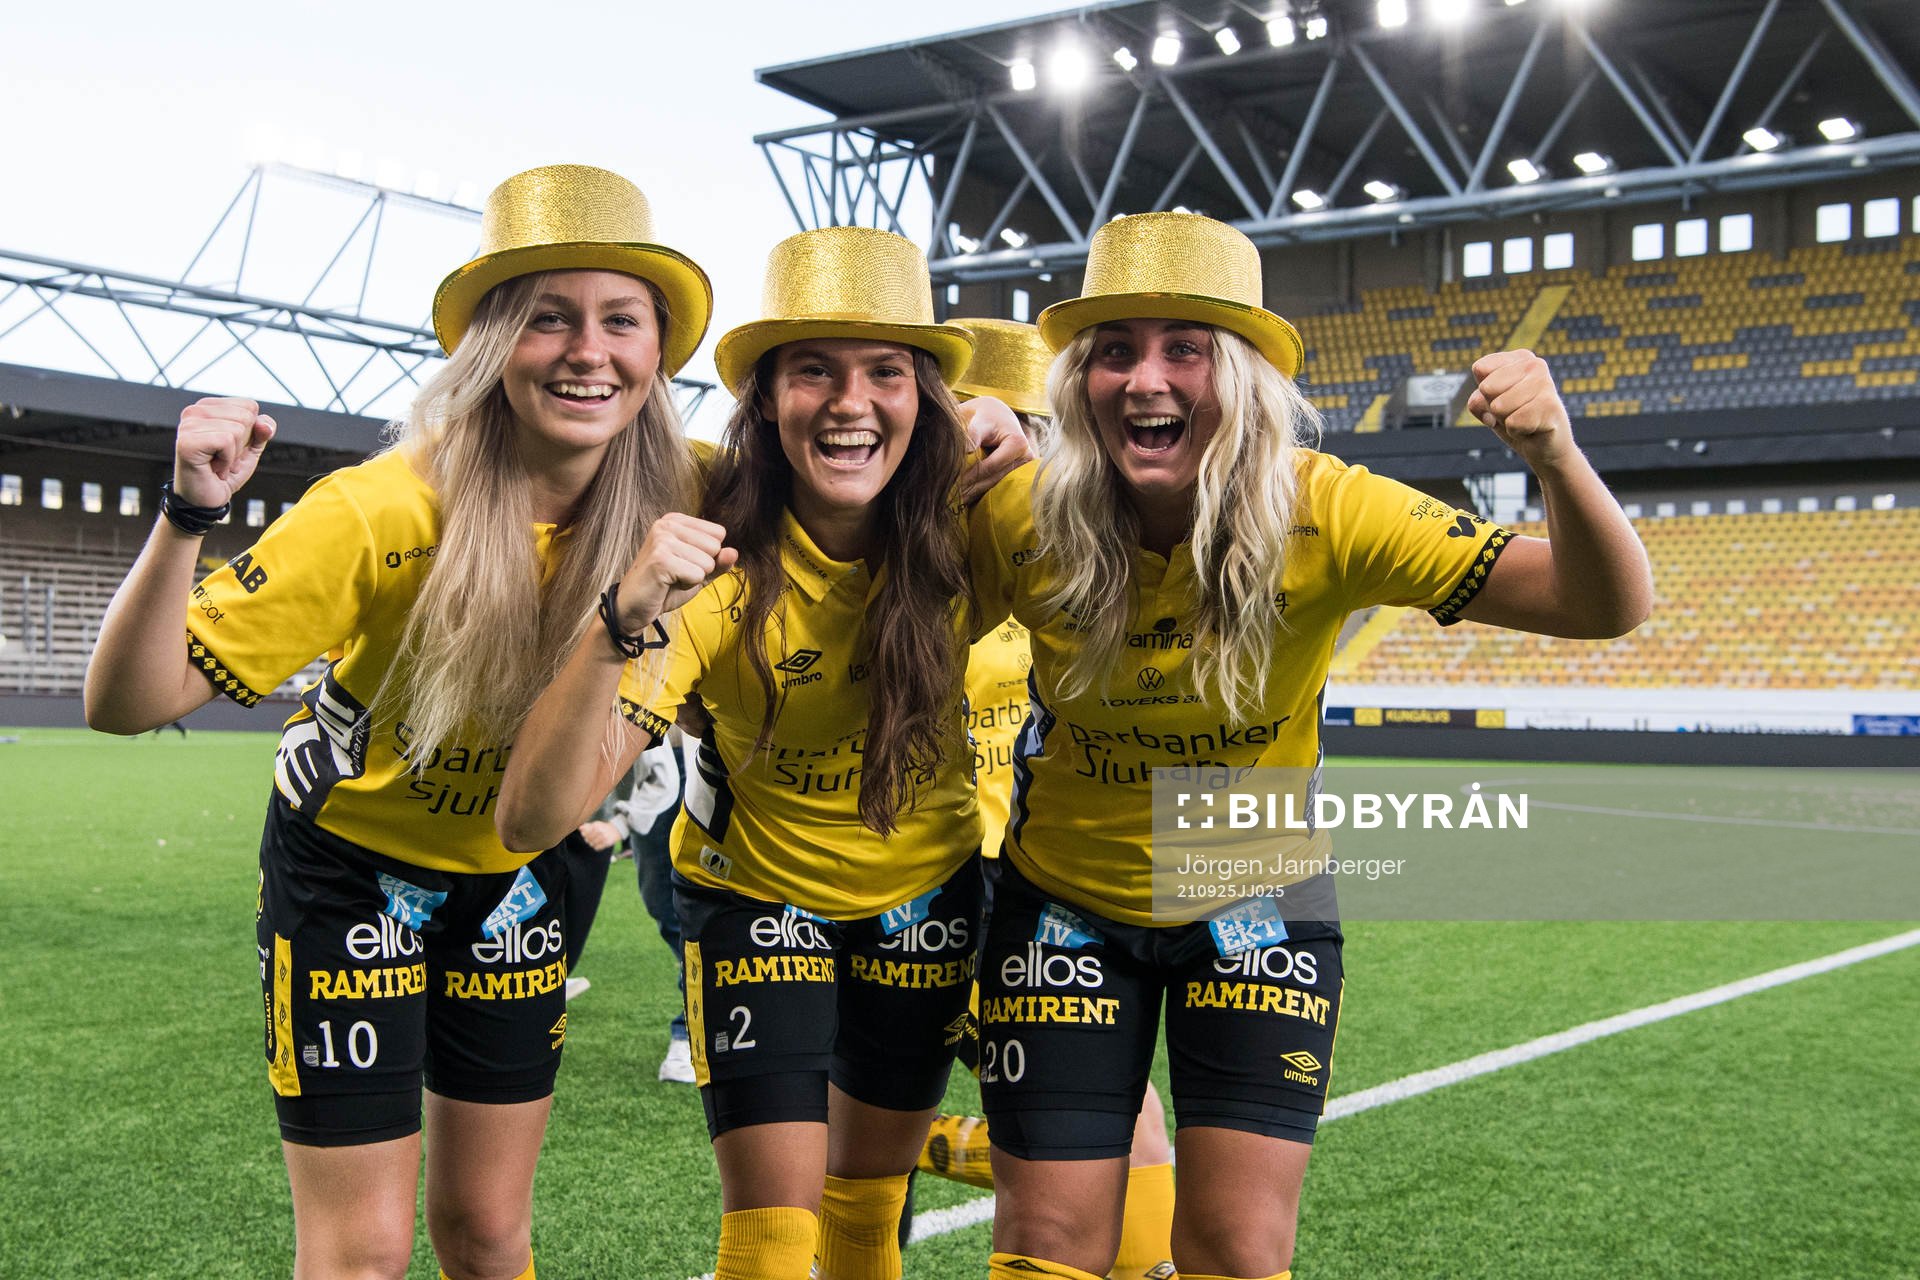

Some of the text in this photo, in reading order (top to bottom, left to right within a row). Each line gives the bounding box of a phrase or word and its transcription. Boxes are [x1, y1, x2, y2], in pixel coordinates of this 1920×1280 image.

[229, 552, 268, 594] AB
[781, 671, 823, 689] umbro
[715, 956, 834, 987] RAMIRENT
[1001, 941, 1104, 988] ellos
[983, 996, 1120, 1025] RAMIRENT
[1186, 981, 1331, 1026] RAMIRENT
[318, 1020, 379, 1069] 10
[729, 1006, 756, 1050] 2
[985, 1039, 1026, 1083] 20
[1284, 1069, 1318, 1086] umbro
